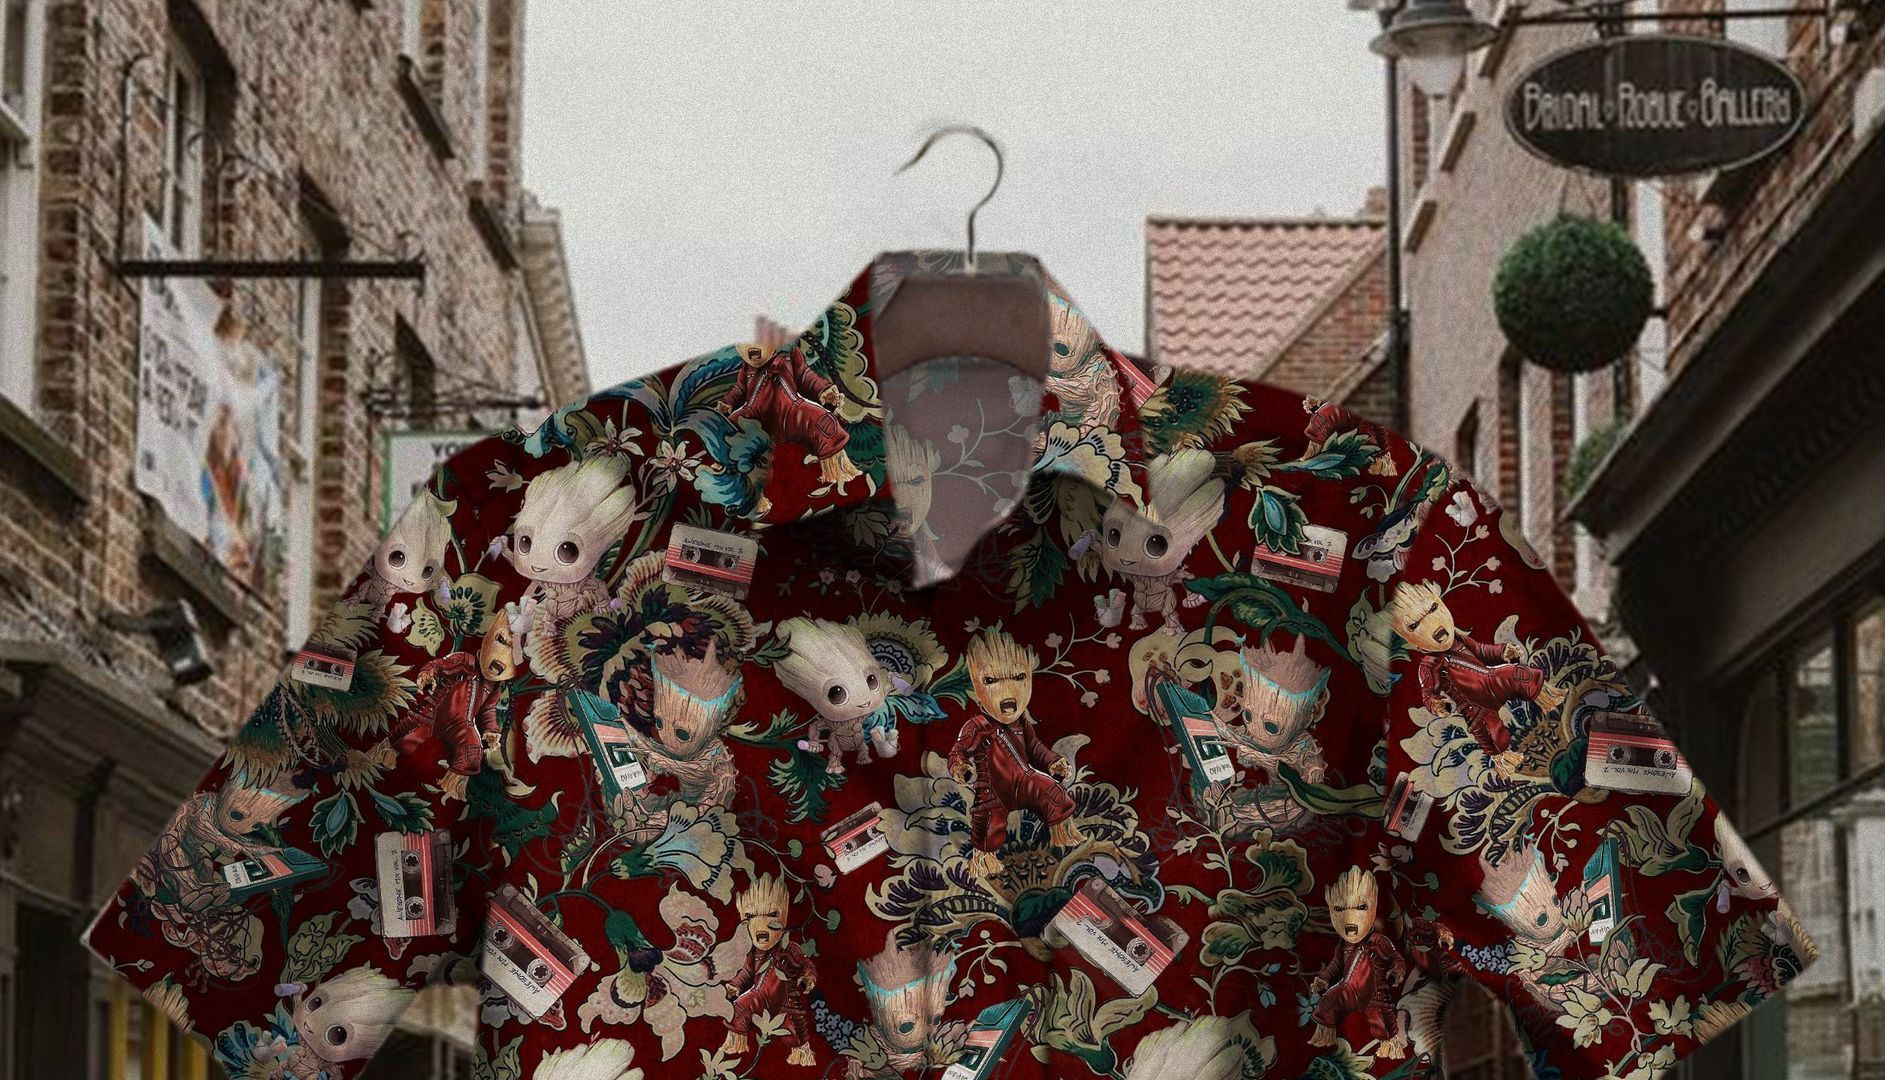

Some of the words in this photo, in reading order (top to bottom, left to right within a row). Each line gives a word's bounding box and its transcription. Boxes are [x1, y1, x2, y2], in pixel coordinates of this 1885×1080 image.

[1700, 77, 1791, 128] GALLERY
[1642, 768, 1676, 778] AWESOME
[394, 887, 404, 921] AWESOME
[1106, 945, 1140, 974] AWESOME
[507, 965, 541, 996] AWESOME
